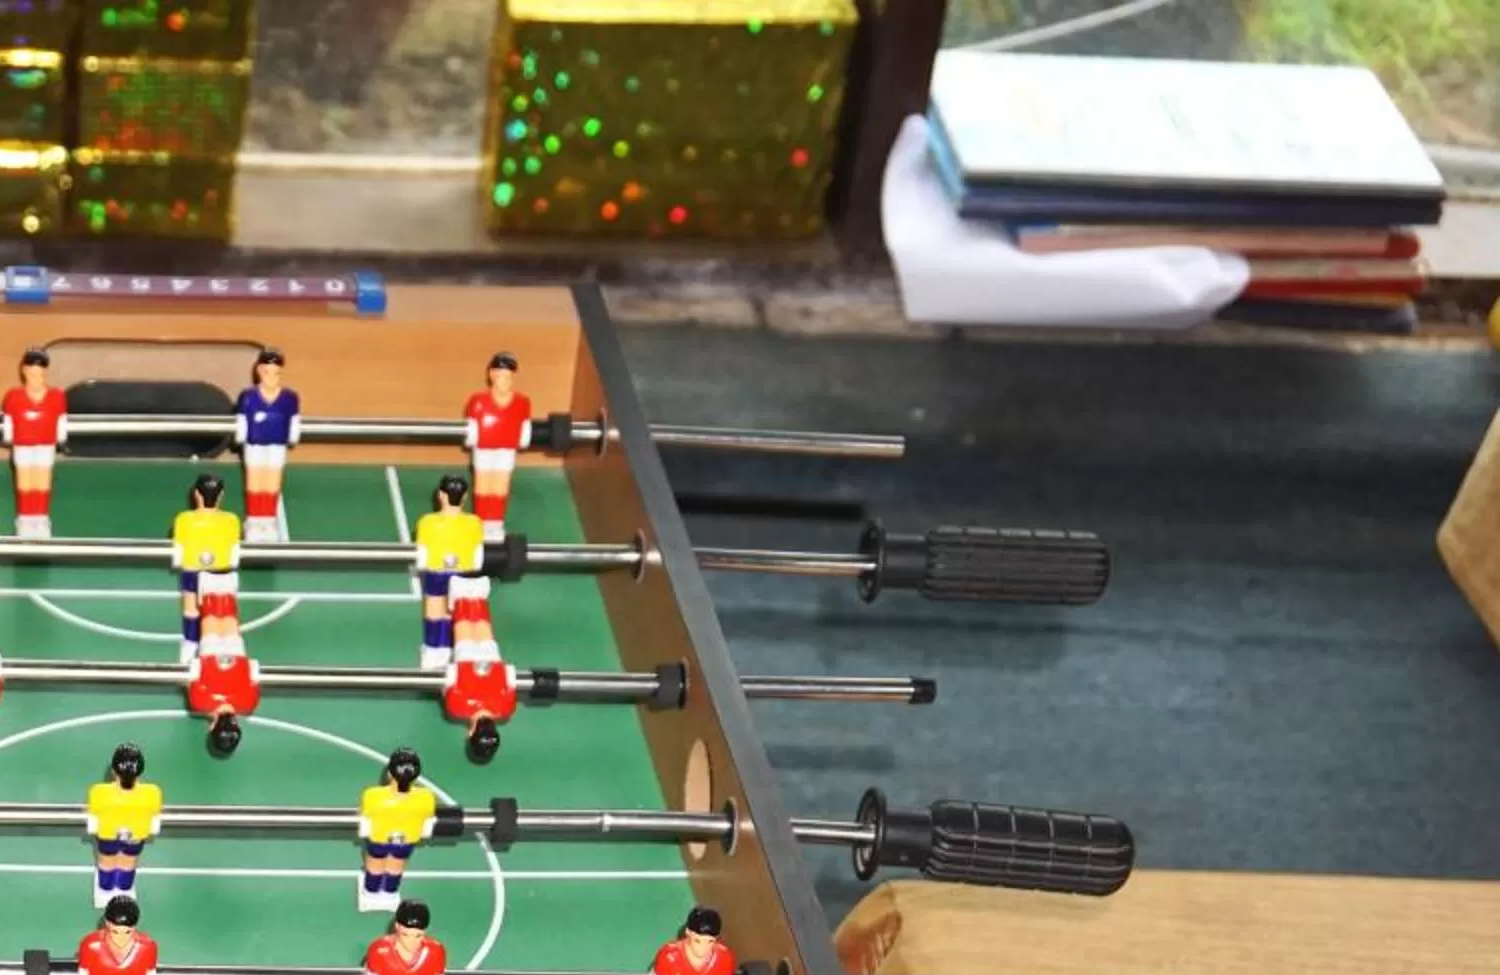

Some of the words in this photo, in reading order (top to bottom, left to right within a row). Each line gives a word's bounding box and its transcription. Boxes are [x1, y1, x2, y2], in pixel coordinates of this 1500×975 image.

[50, 276, 72, 291] 7
[91, 277, 112, 291] 6
[131, 278, 150, 292] 5
[171, 279, 192, 292] 4
[210, 279, 229, 292] 3
[250, 279, 269, 292] 2
[289, 279, 304, 293] 1
[325, 279, 345, 293] 0
